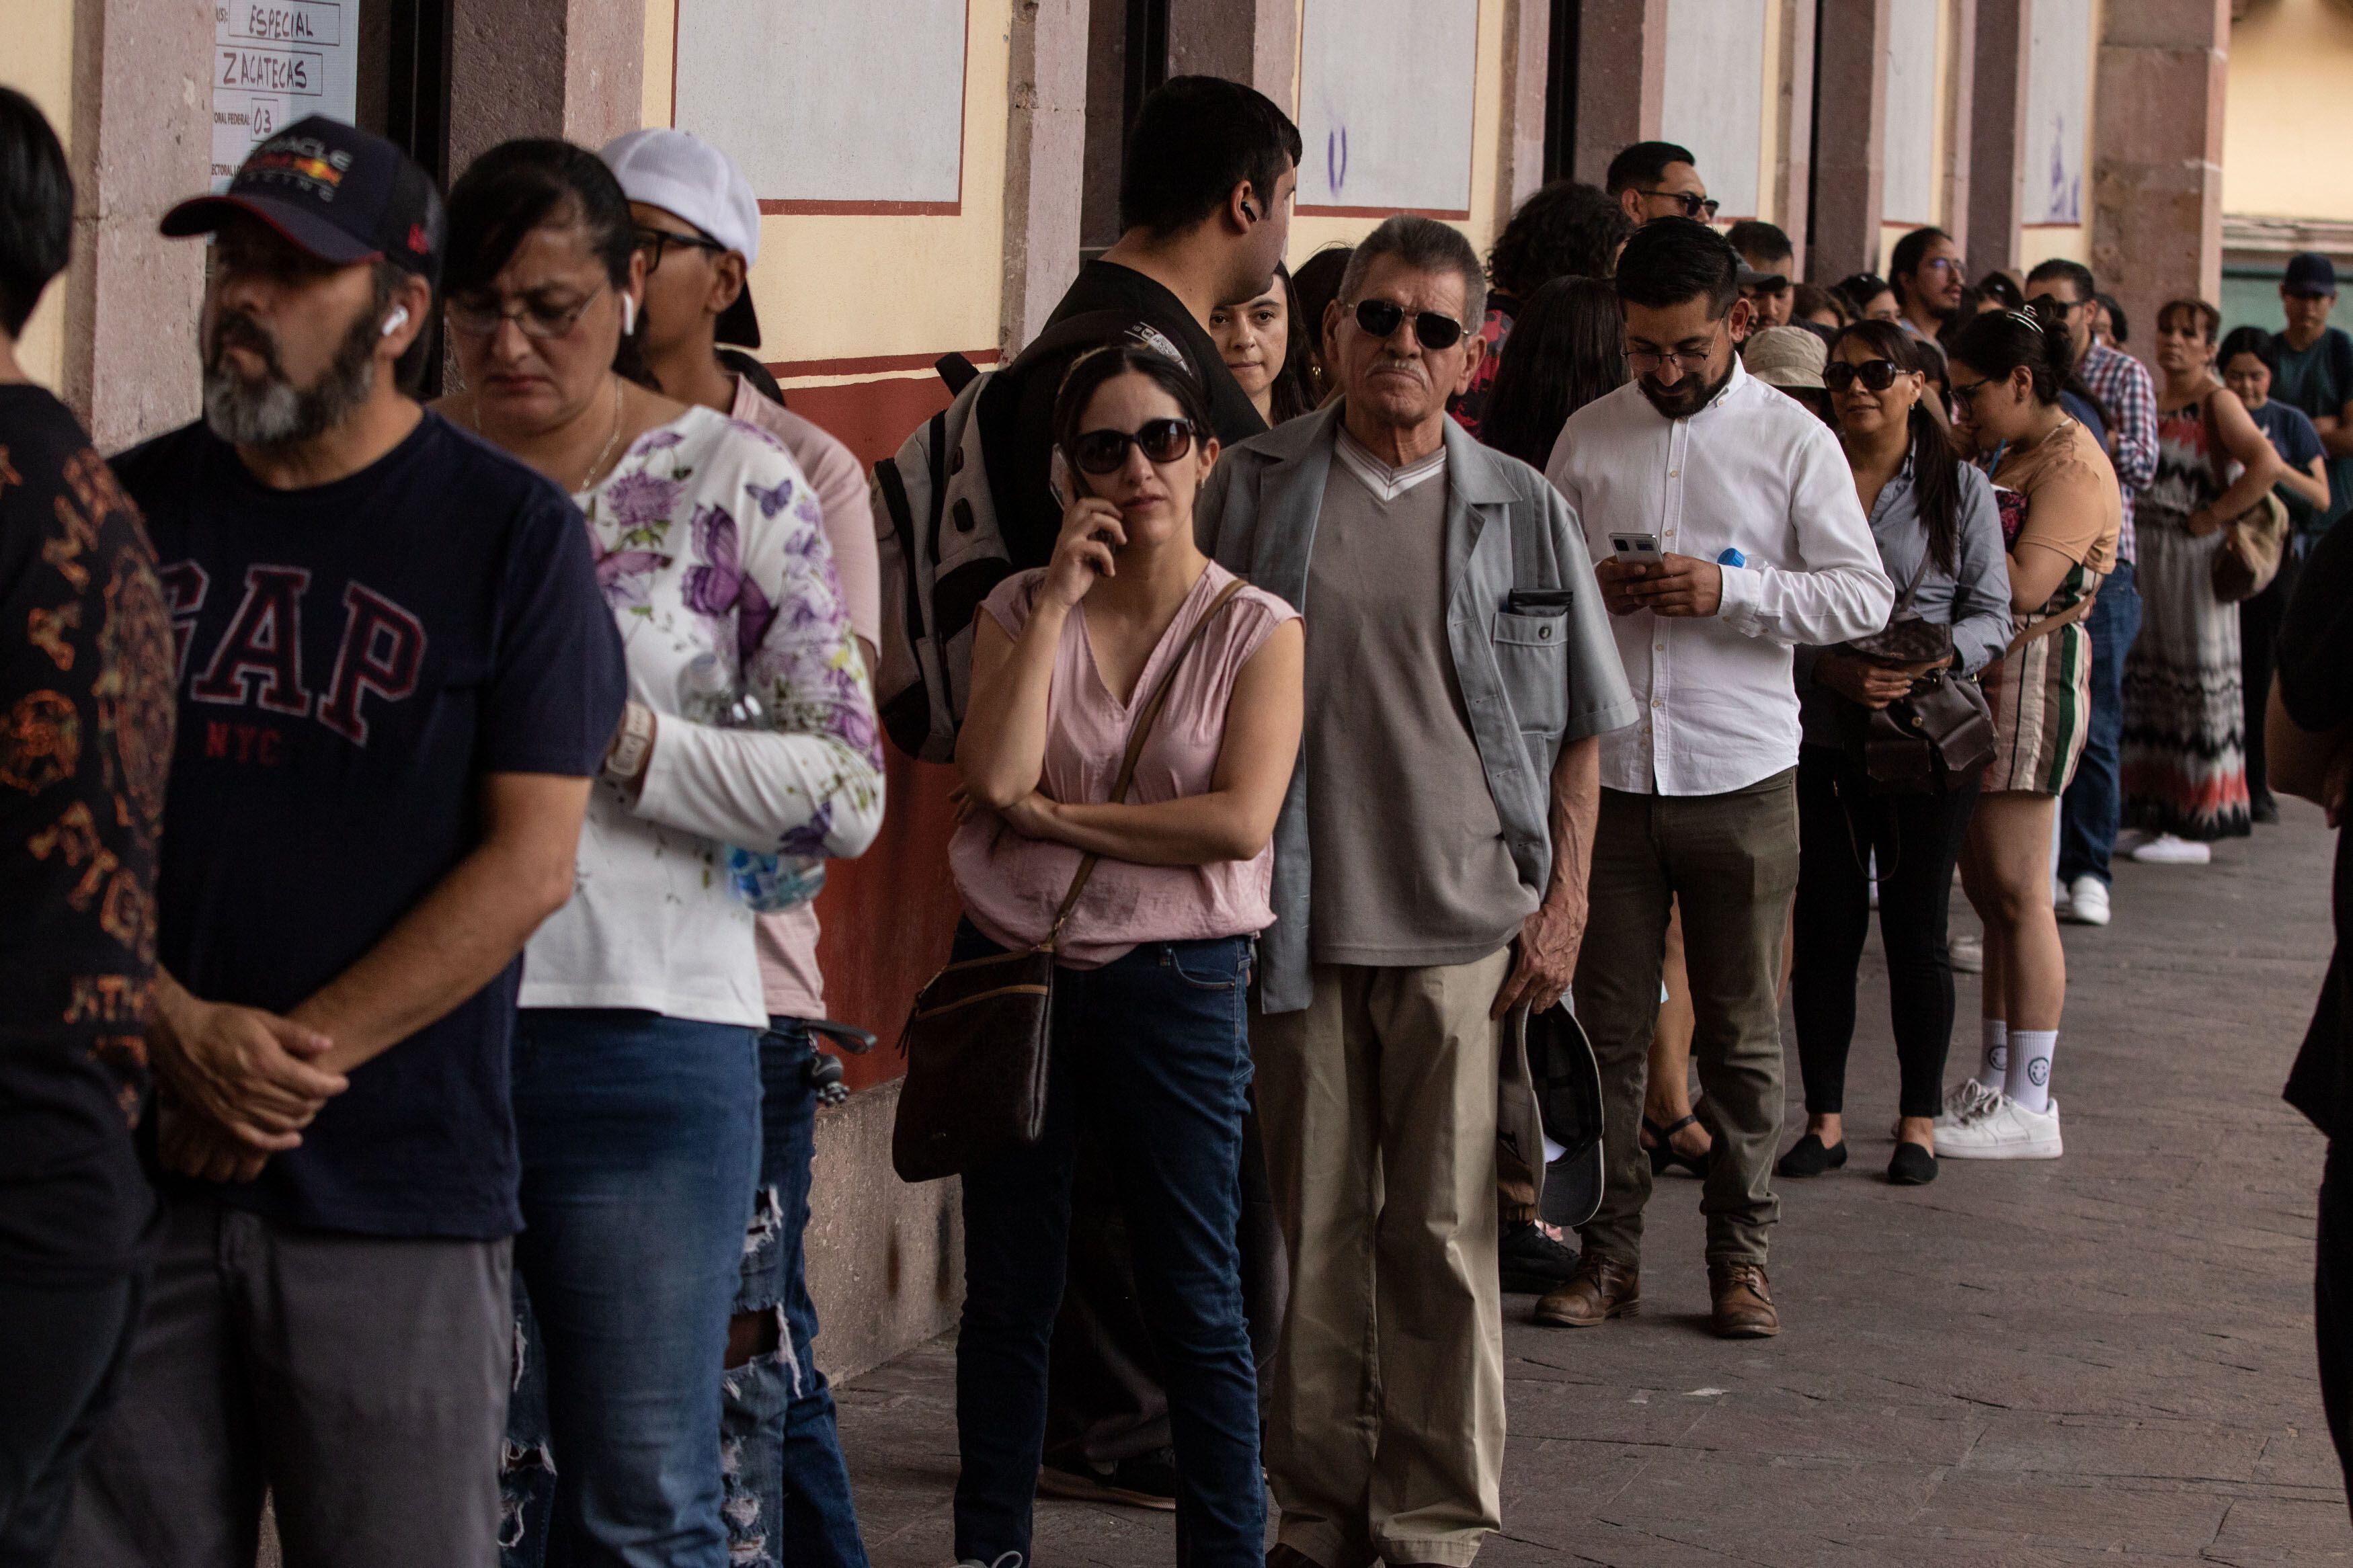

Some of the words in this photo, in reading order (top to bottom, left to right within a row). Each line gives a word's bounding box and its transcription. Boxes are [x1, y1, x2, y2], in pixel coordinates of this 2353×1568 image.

[249, 4, 313, 39] ESPECIAL
[223, 52, 307, 89] ZACATECAS
[214, 112, 227, 124] ORAL
[253, 107, 272, 134] 03
[211, 164, 233, 177] ECTORAL
[205, 720, 282, 766] NYC
